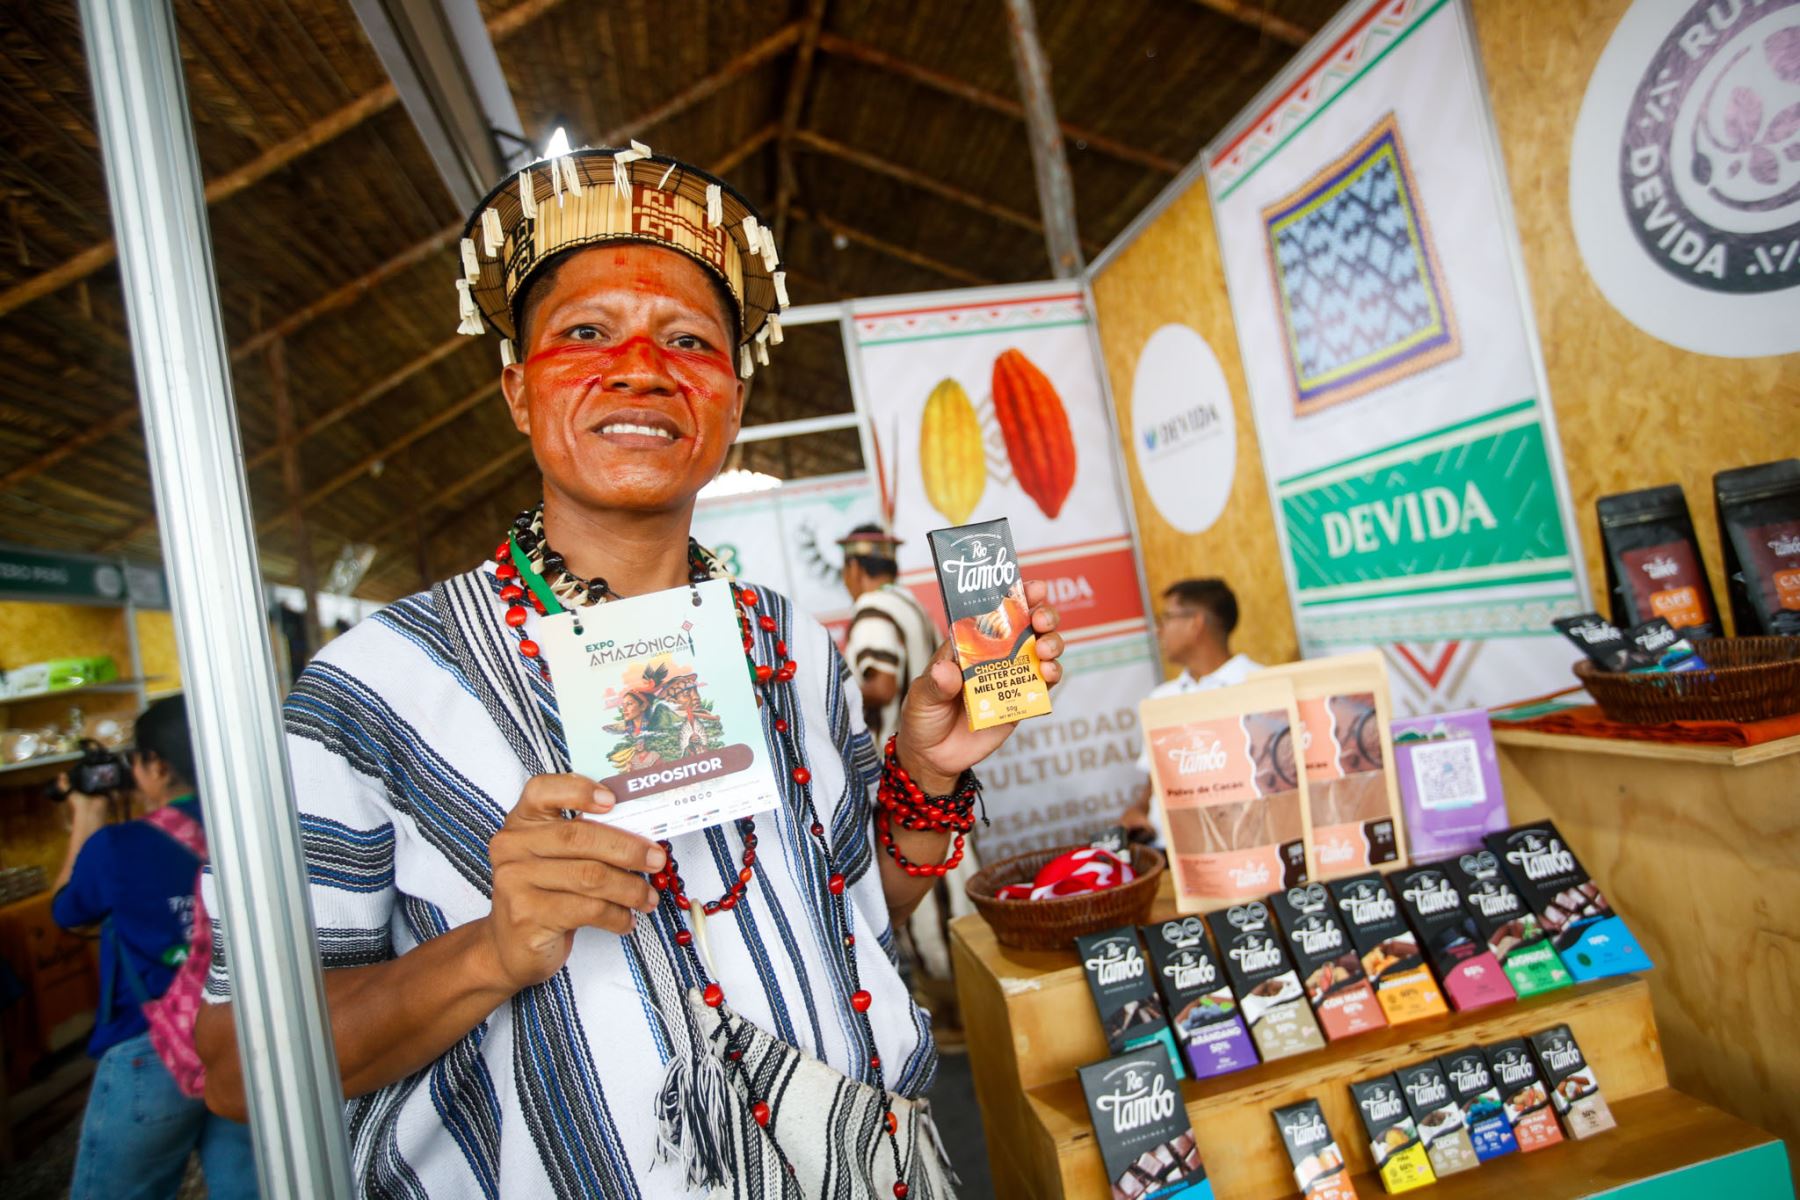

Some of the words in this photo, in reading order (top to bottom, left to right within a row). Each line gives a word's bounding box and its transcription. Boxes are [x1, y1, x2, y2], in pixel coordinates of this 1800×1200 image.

[1678, 0, 1756, 60] RU
[1630, 145, 1726, 279] DEVIDA
[1321, 480, 1498, 559] DEVIDA
[585, 640, 615, 653] EXPO
[590, 633, 688, 667] AMAZÓNICA
[974, 655, 1031, 674] CHOCOLATE
[978, 670, 1009, 684] BITTER
[1010, 665, 1030, 676] CON
[974, 683, 995, 694] MIEL
[996, 680, 1008, 690] DE
[1010, 673, 1038, 687] ABEJA
[997, 688, 1021, 701] 80%
[627, 757, 723, 793] EXPOSITOR
[978, 736, 1143, 792] ULTURAL
